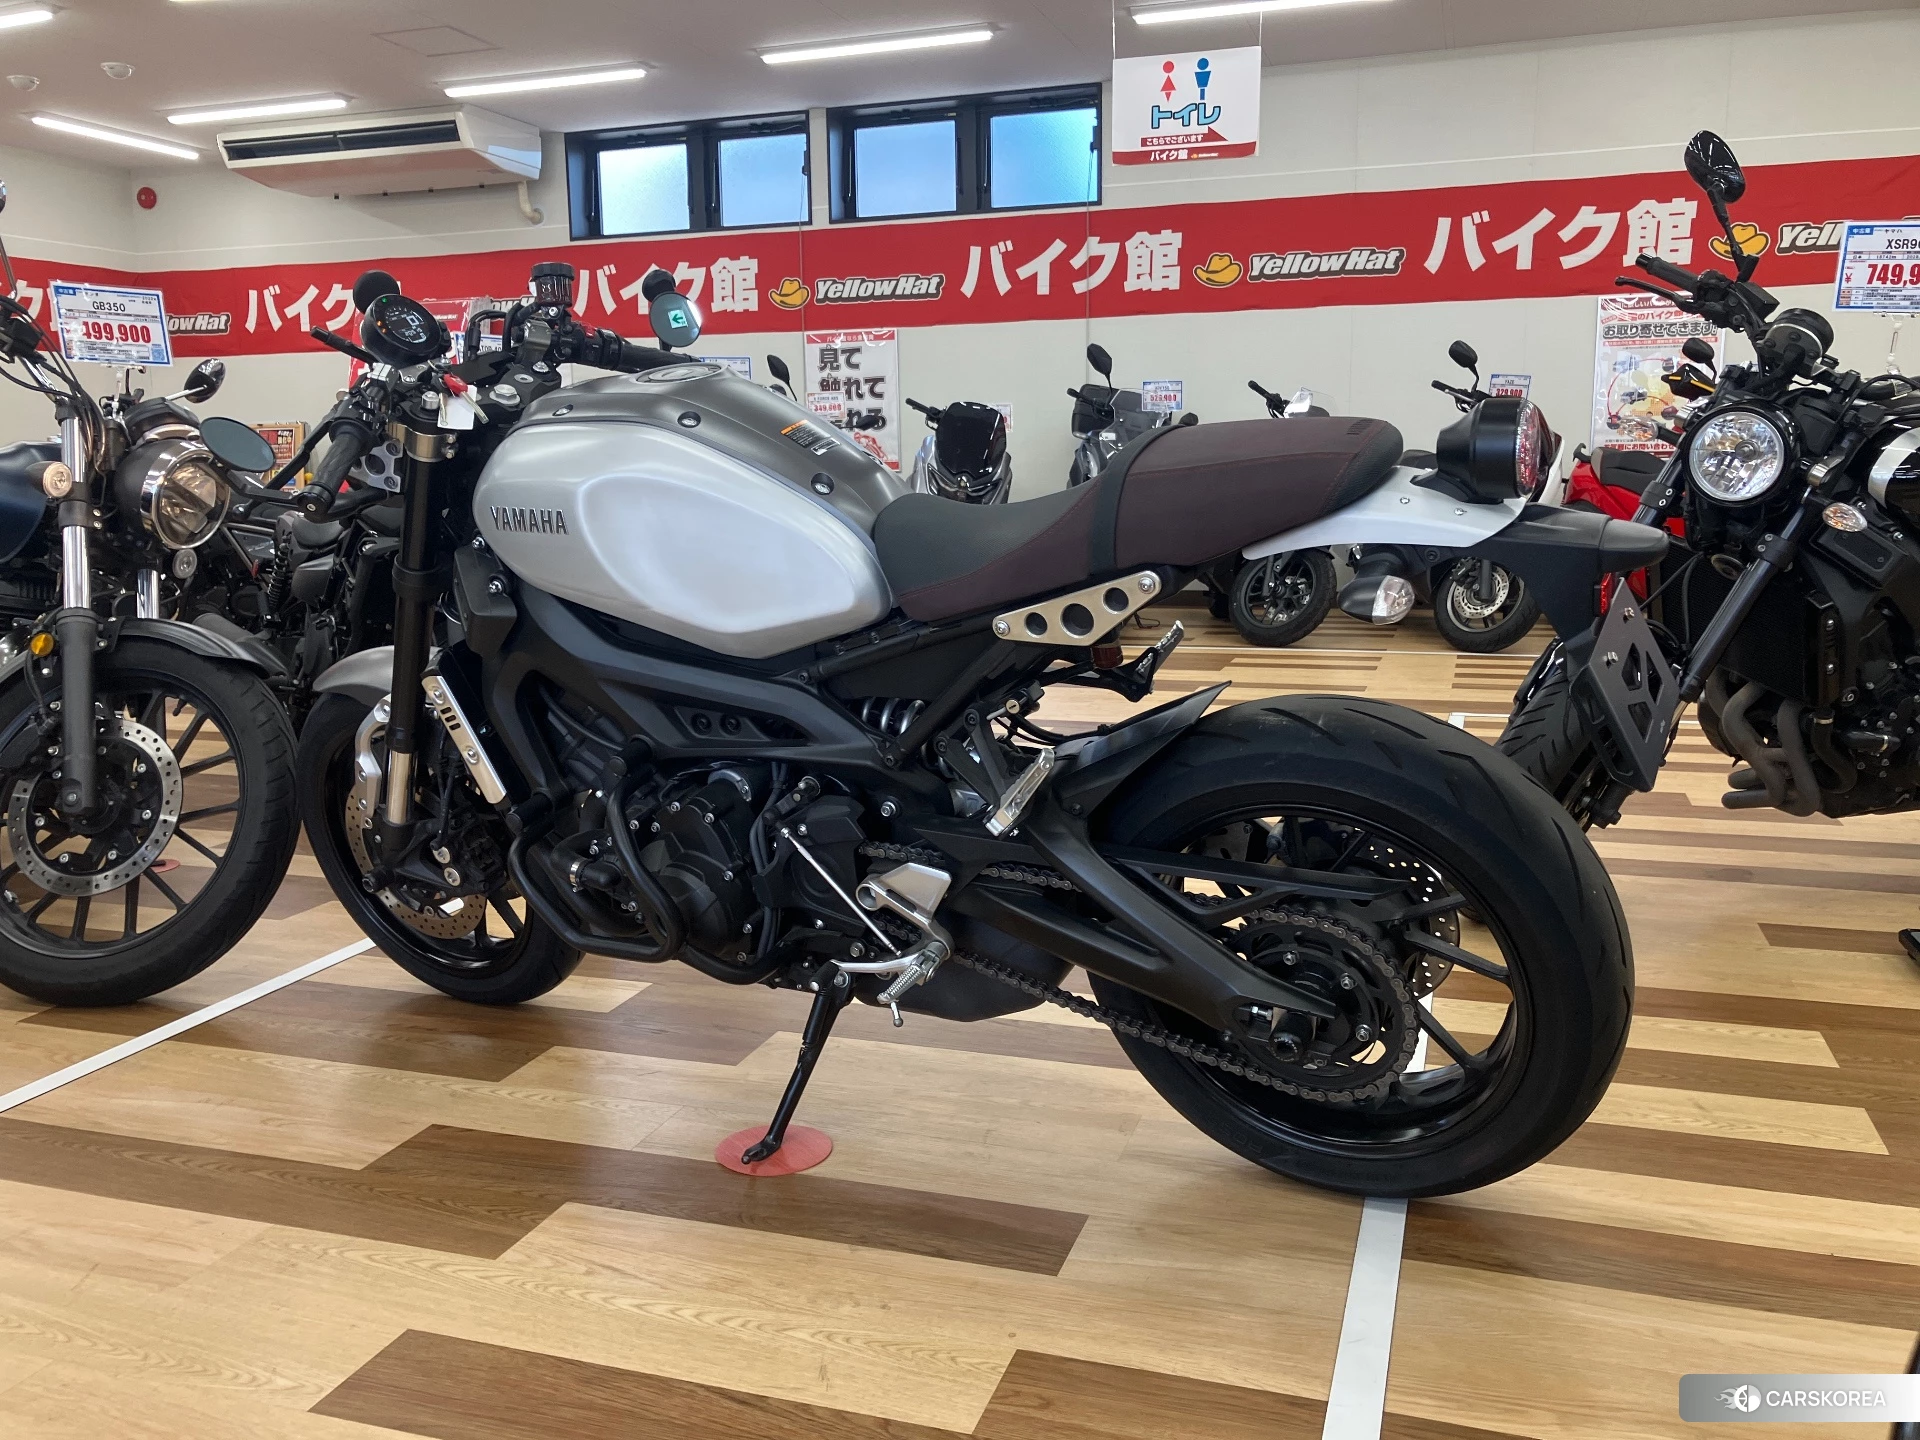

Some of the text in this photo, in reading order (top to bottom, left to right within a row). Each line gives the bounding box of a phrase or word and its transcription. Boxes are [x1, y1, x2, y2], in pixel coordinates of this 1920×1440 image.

[1151, 102, 1221, 129] トイレ
[1146, 134, 1204, 146] こちらでございます
[1150, 149, 1189, 161] バイク館
[1423, 197, 1698, 275] バイク館
[1779, 223, 1841, 249] Yell
[1885, 238, 1920, 250] XSR9
[960, 229, 1183, 299] バイク館
[1249, 249, 1402, 278] YellowHat
[573, 255, 759, 317] バイク館
[815, 275, 942, 301] YellowHat
[92, 300, 126, 313] GB350
[245, 283, 401, 334] バイク
[817, 346, 862, 373] 見て
[490, 505, 569, 535] YAMAHA
